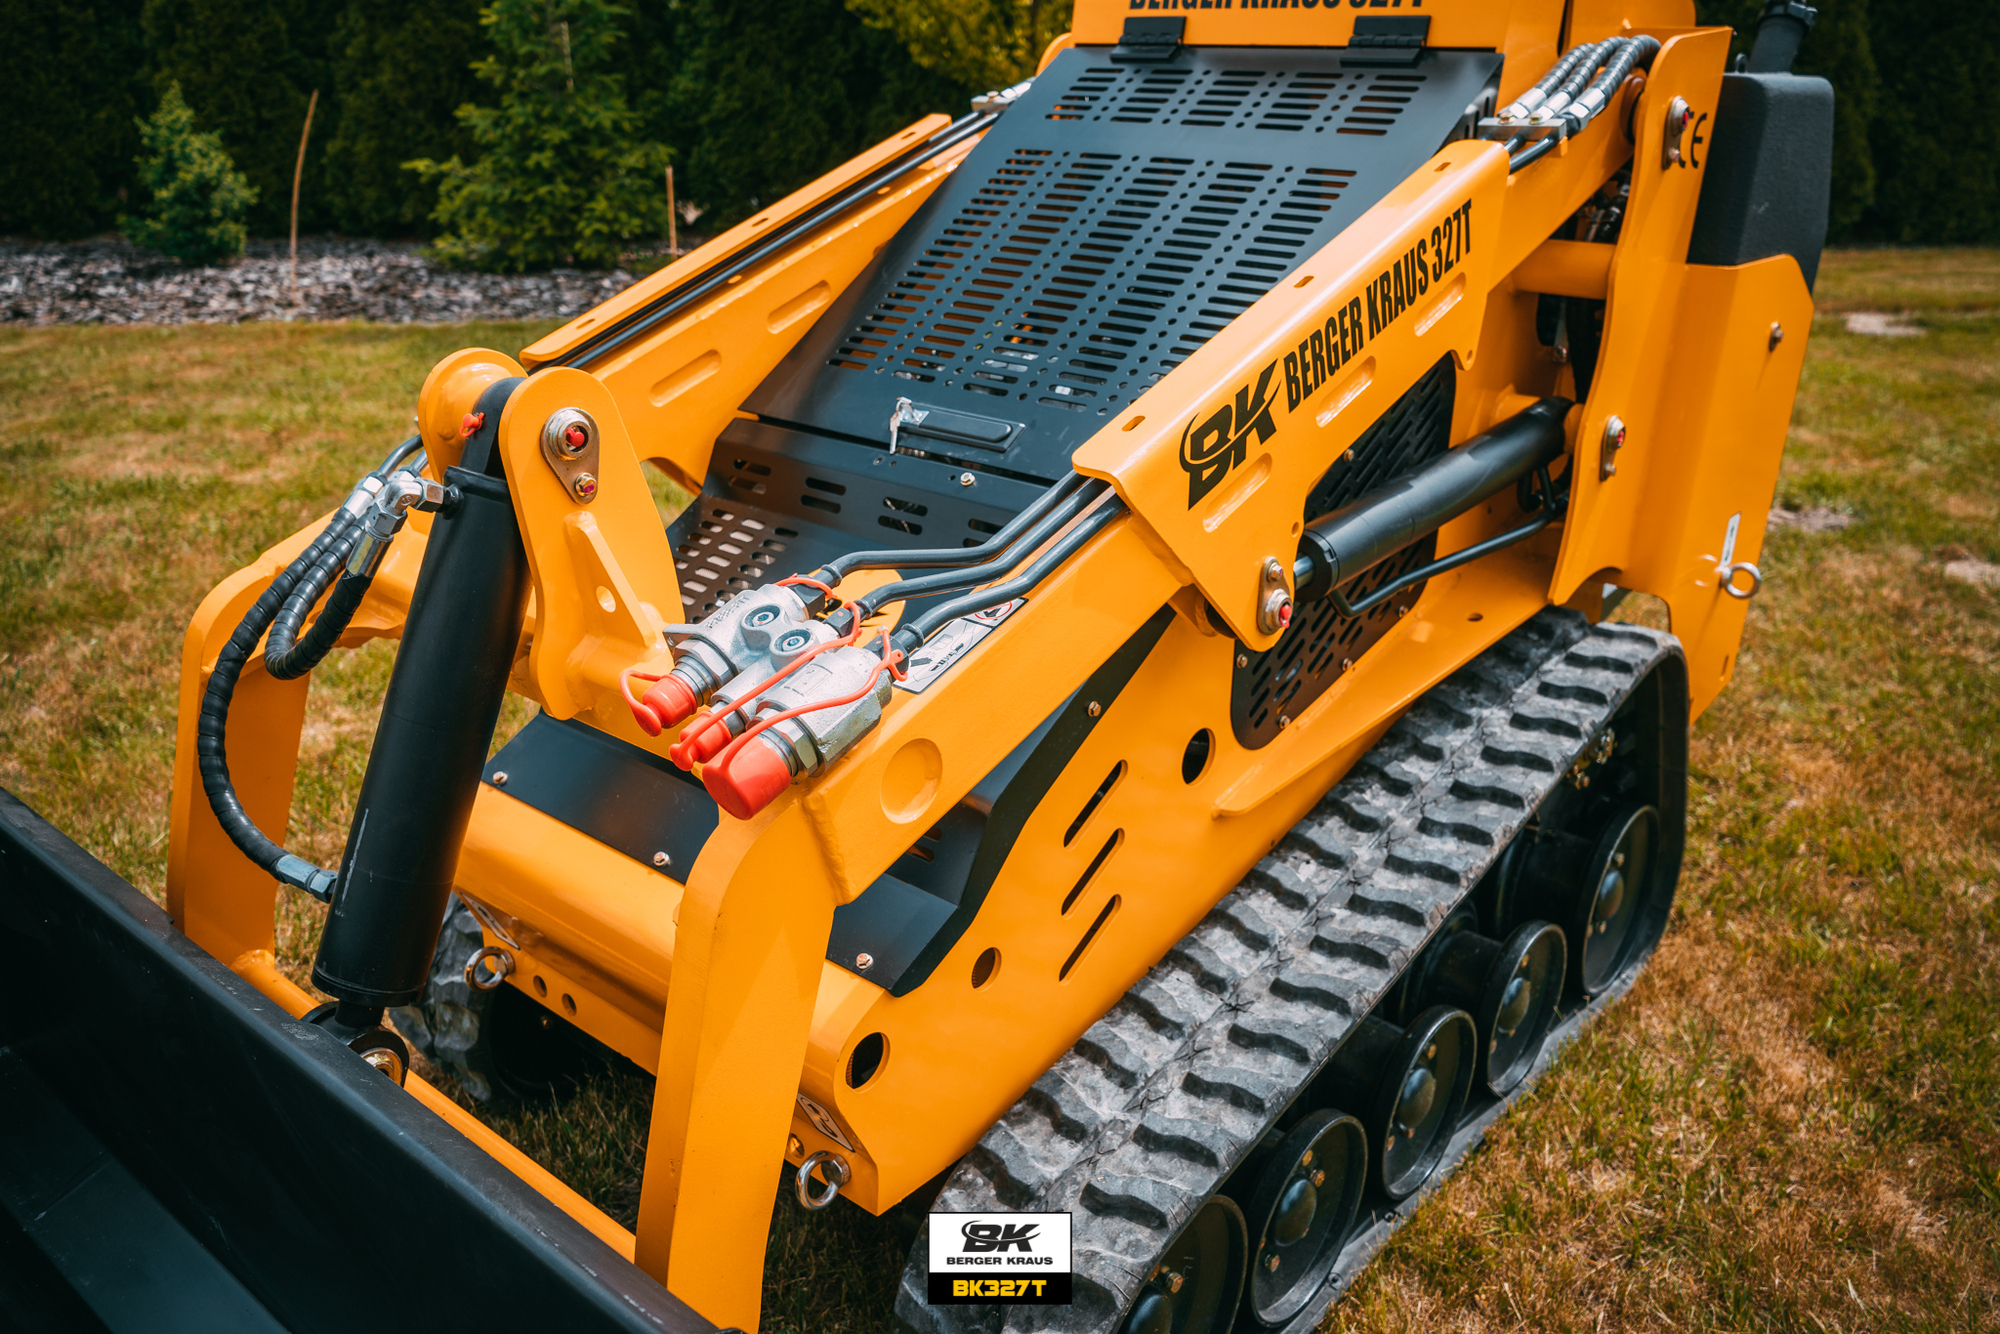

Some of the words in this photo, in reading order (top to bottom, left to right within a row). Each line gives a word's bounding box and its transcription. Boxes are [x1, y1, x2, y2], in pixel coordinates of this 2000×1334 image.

[1180, 358, 1281, 511] BK
[1283, 296, 1364, 414] BERGER
[1366, 238, 1428, 341] KRAUS
[1431, 198, 1471, 283] 327T
